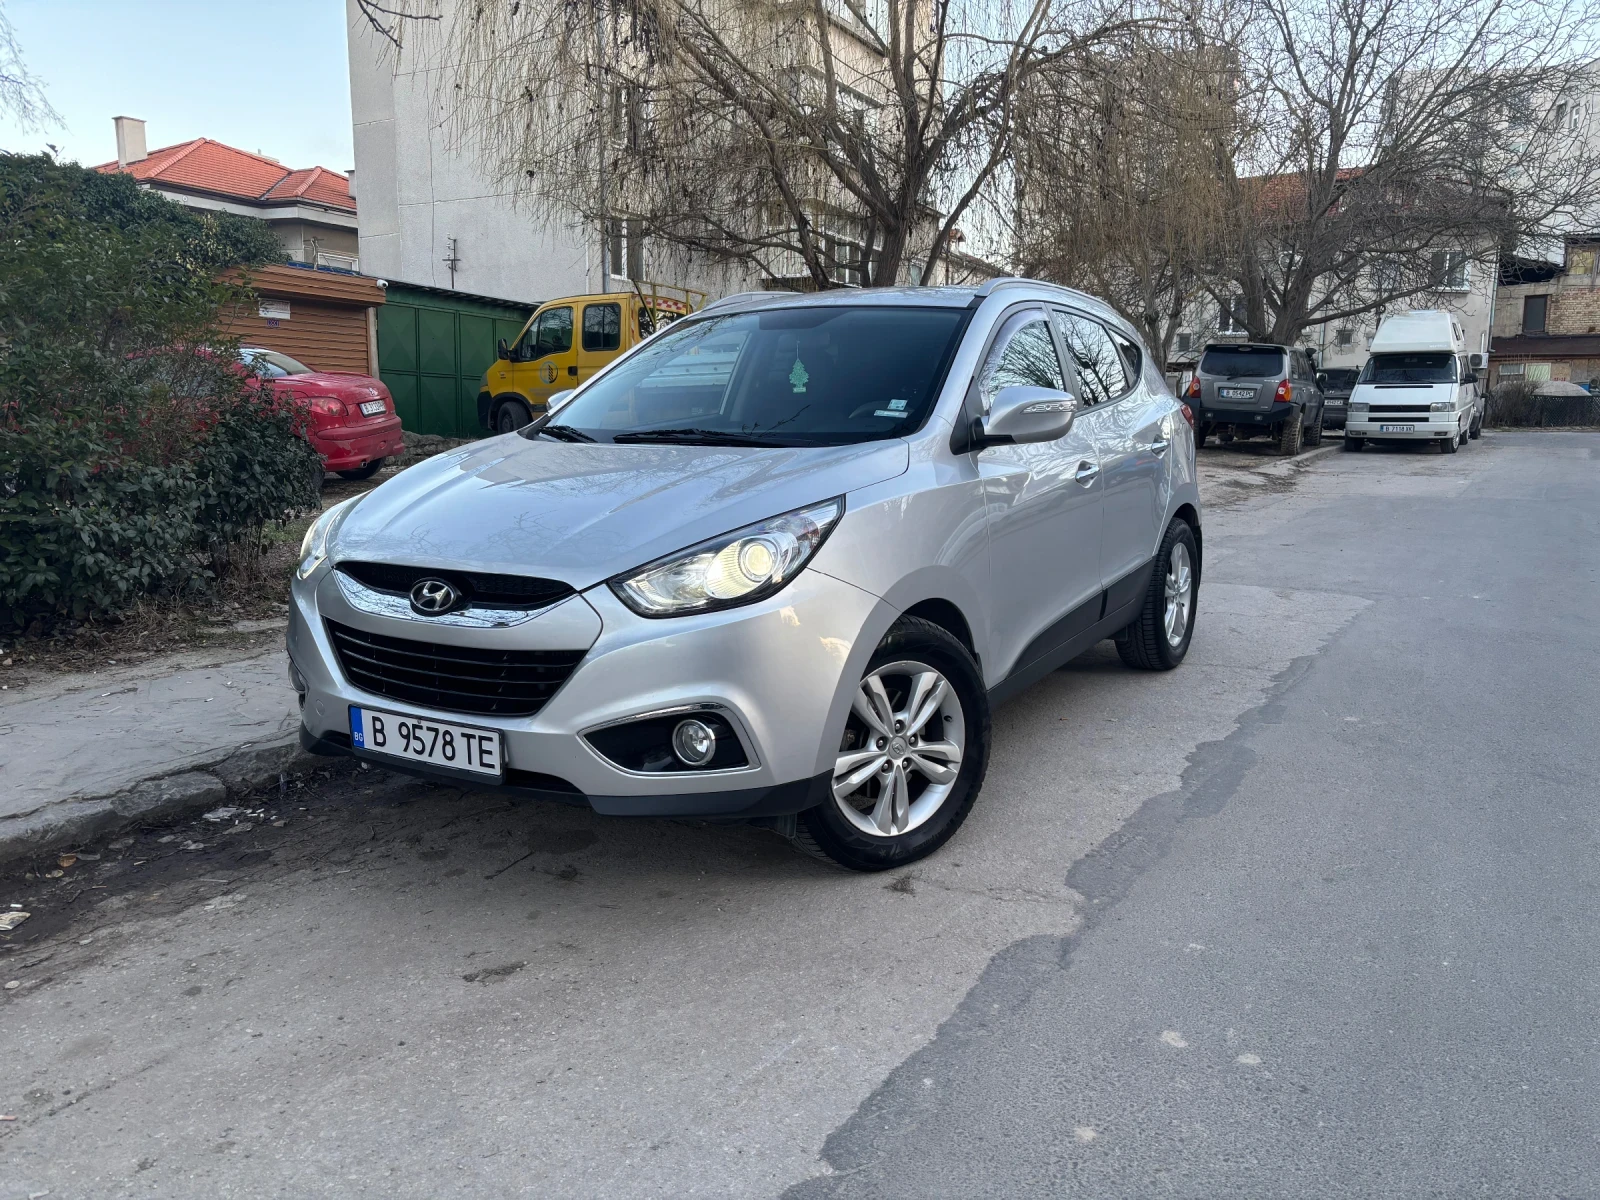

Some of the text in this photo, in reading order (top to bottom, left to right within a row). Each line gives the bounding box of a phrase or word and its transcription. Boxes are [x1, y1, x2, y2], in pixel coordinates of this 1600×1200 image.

[354, 732, 364, 742] BG
[372, 716, 496, 769] B 9578 TE
